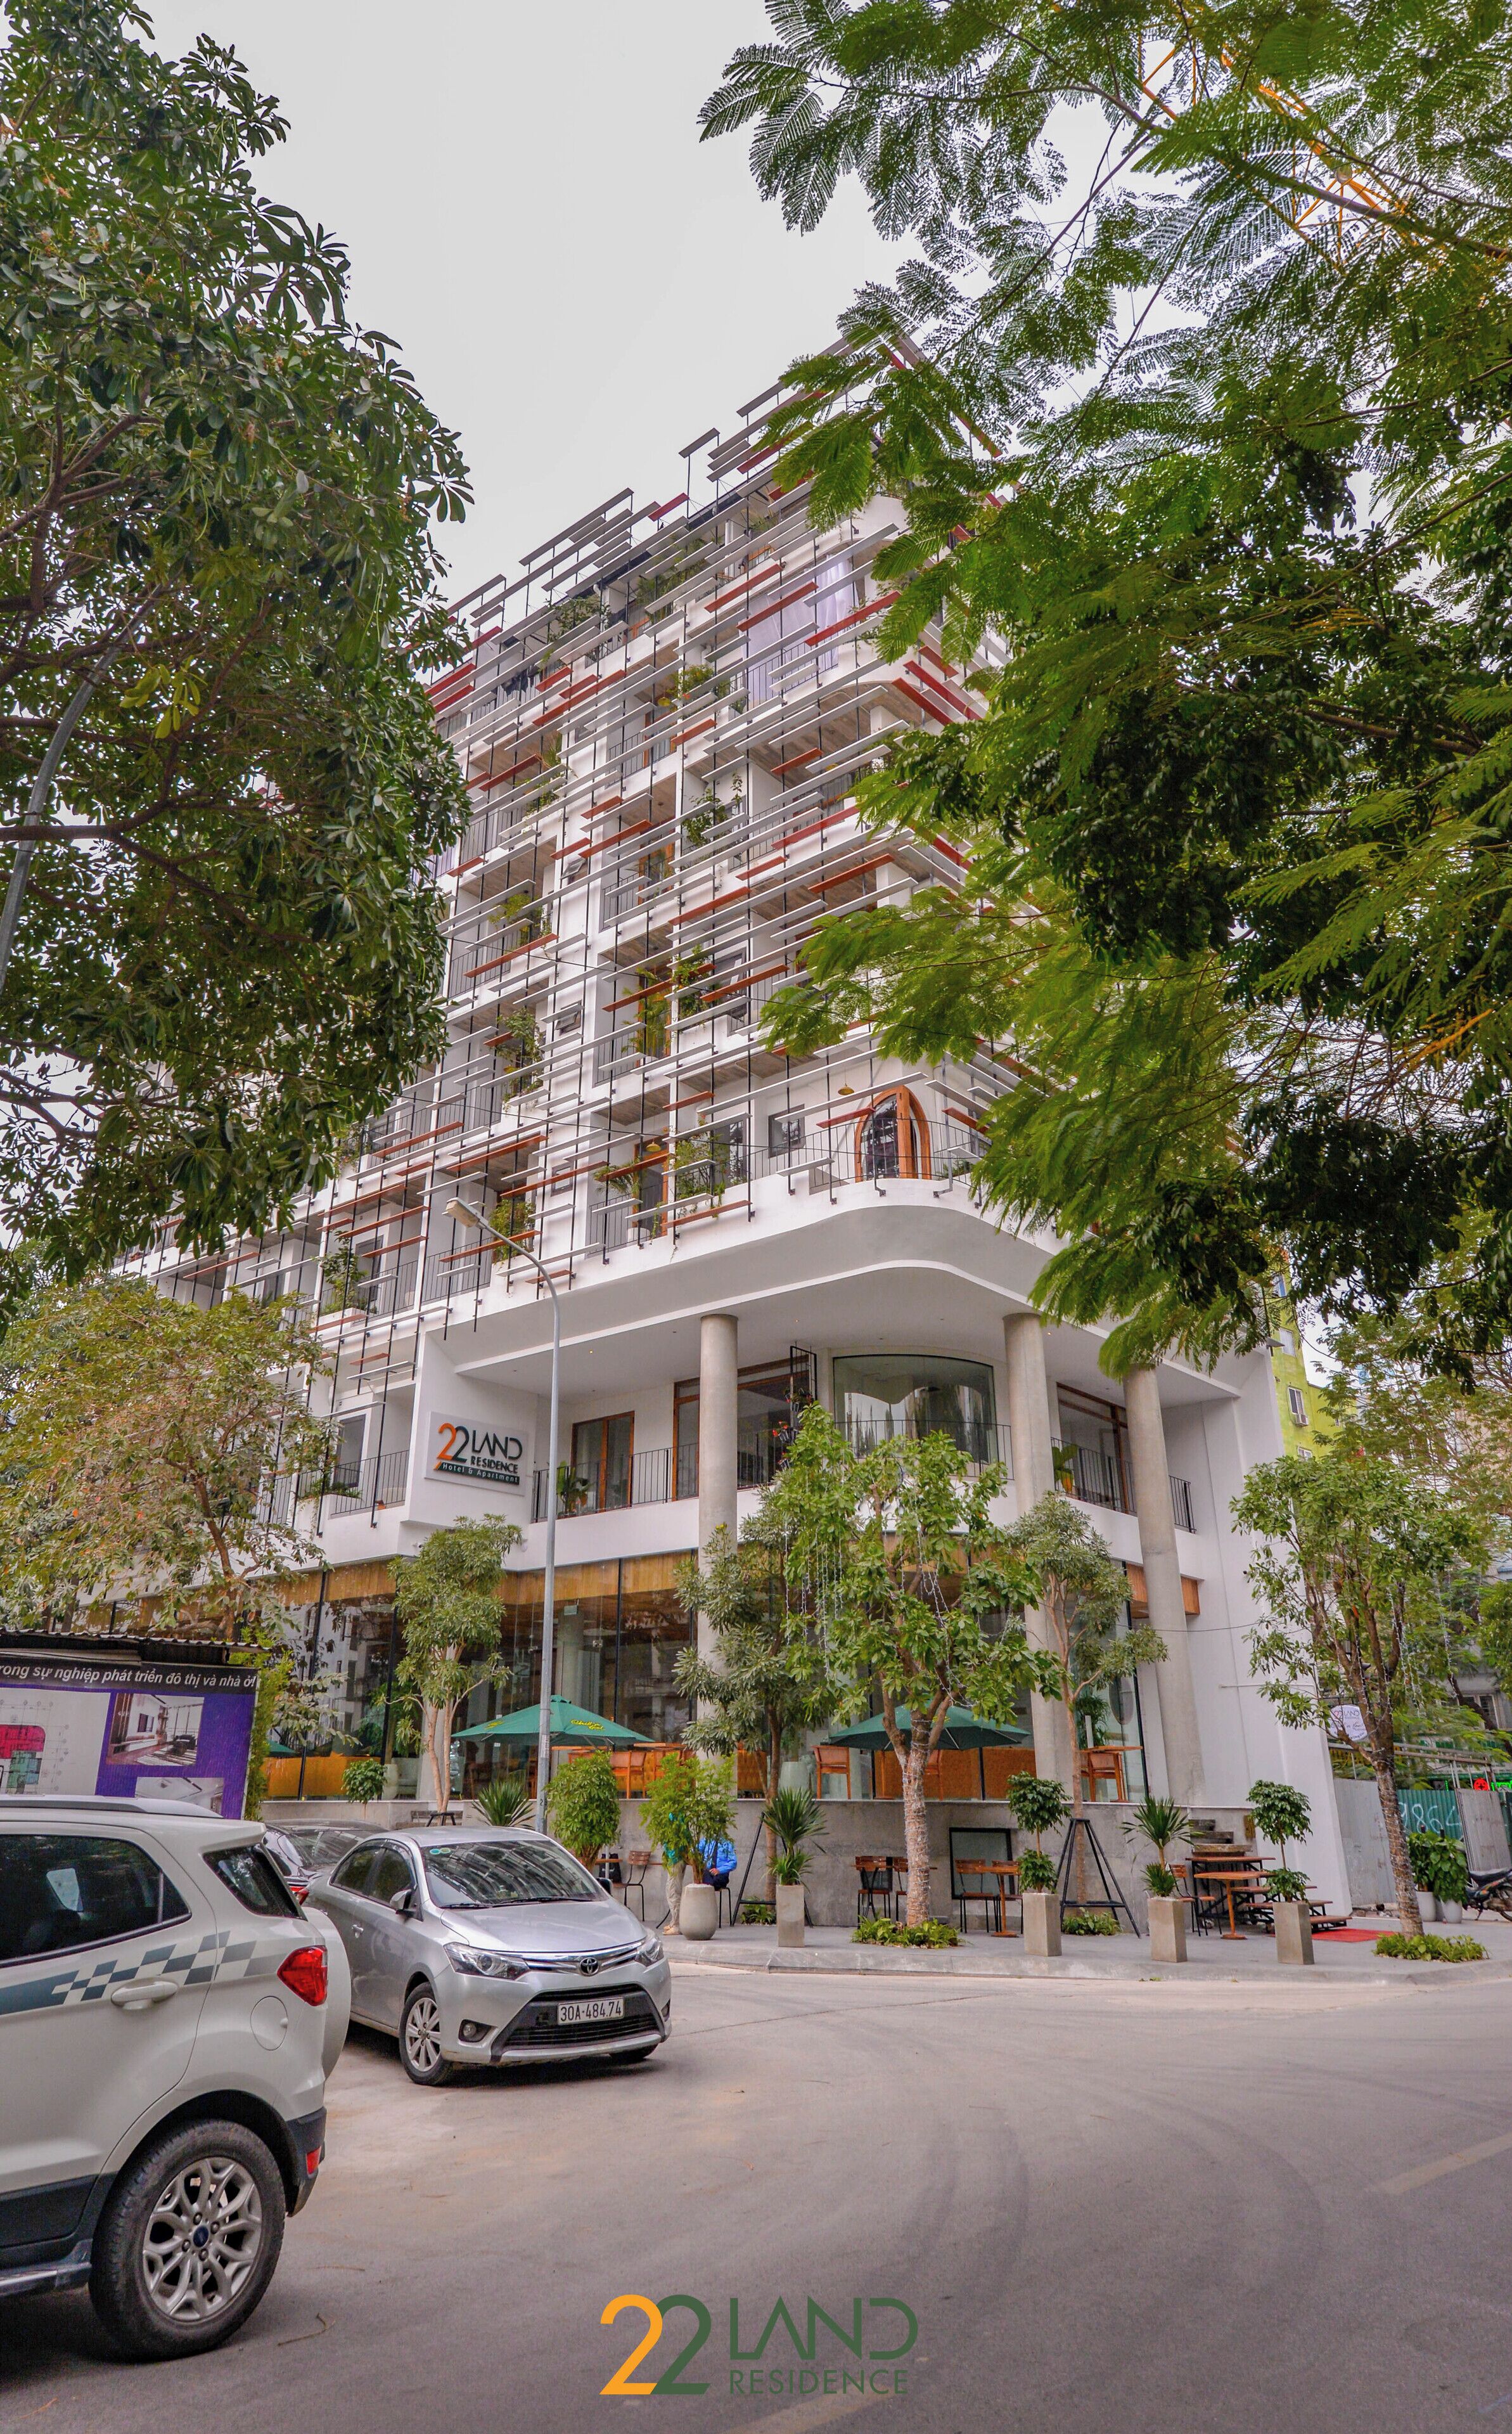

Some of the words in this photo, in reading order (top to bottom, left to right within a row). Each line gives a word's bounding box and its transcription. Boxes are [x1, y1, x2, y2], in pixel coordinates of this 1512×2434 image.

[437, 1422, 470, 1463] 22
[471, 1430, 523, 1460] LAND
[442, 1463, 464, 1472] Hotel
[477, 1469, 518, 1483] Apartment
[470, 1455, 518, 1474] RESIDENCE
[33, 1666, 53, 1680] sự
[54, 1666, 99, 1684] nghiệp
[101, 1668, 132, 1684] phát
[135, 1668, 163, 1683] triển
[166, 1673, 182, 1684] đô
[184, 1673, 202, 1688] thị
[203, 1675, 216, 1686] và
[219, 1675, 240, 1687] nhà
